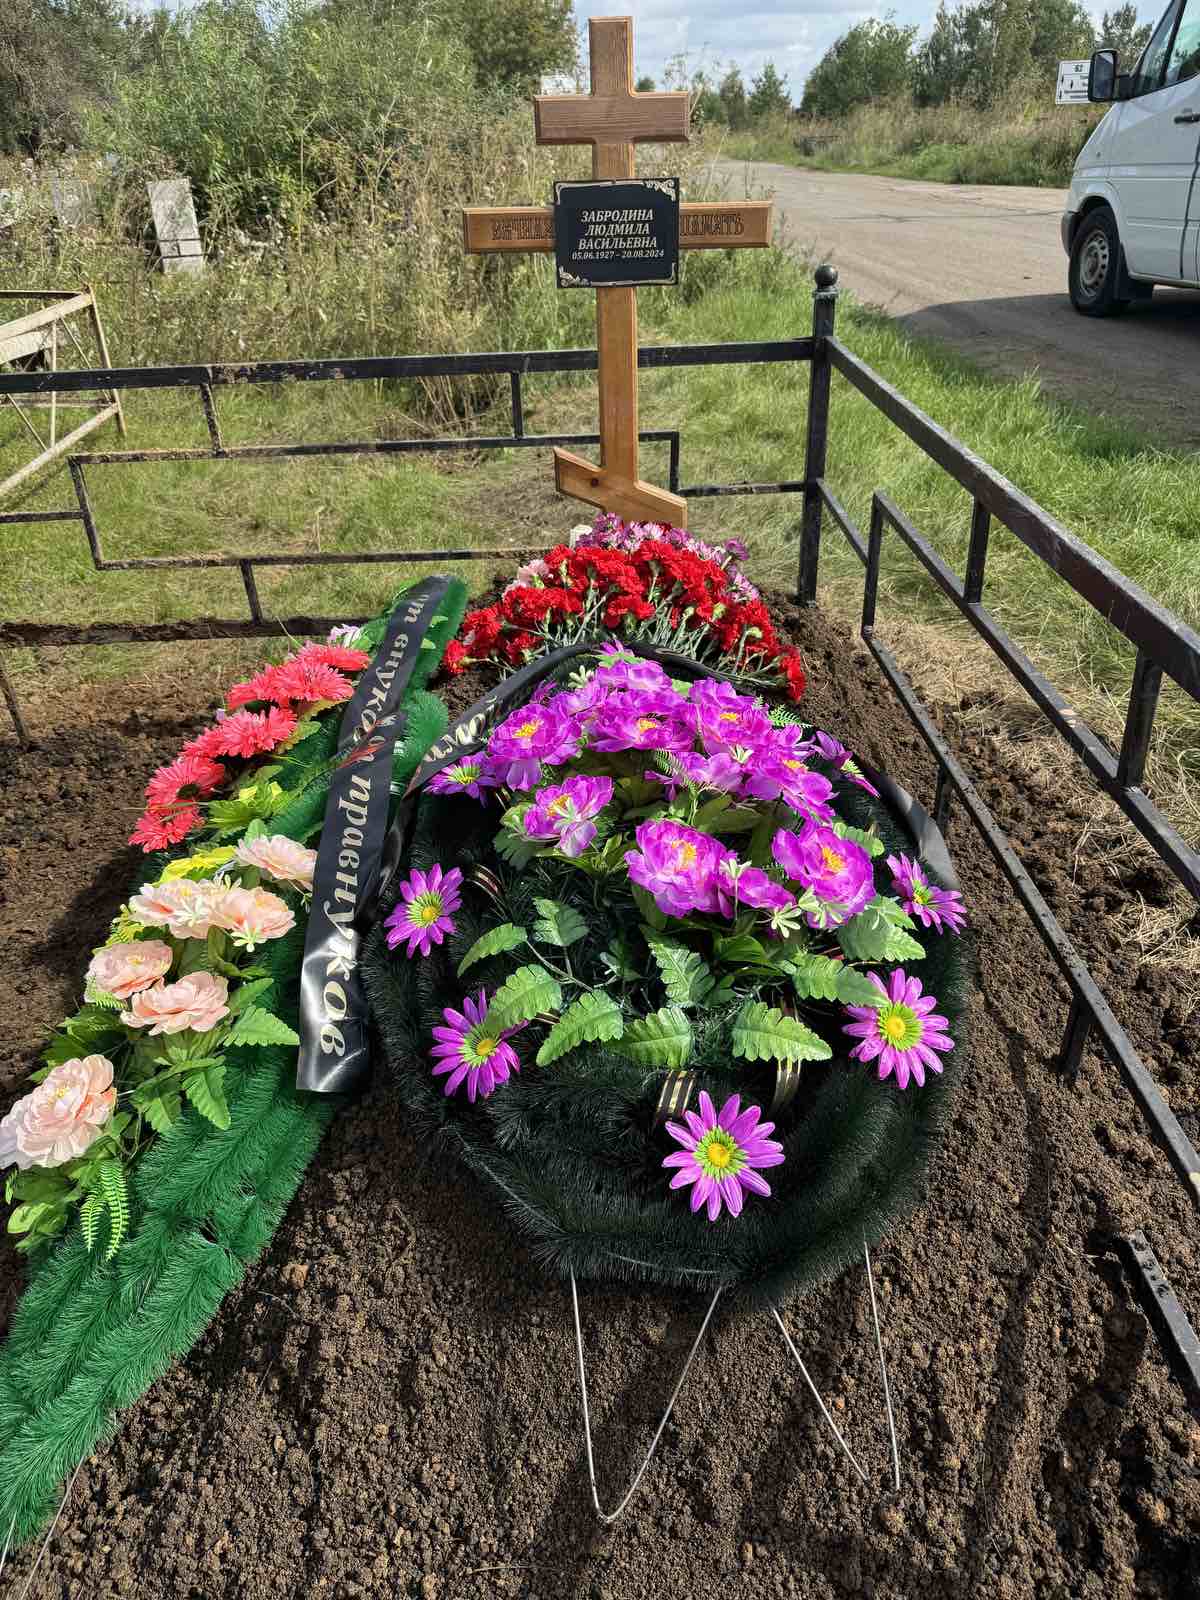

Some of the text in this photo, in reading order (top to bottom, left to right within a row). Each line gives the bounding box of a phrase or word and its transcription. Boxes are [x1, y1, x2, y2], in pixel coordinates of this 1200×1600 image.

[580, 209, 654, 223] ЗАБРОДИНА
[584, 223, 650, 237] ЛЮДМИЛА
[578, 237, 657, 250] ВАСИЛЬЕВНА
[571, 250, 615, 260] 05.06.1927
[621, 249, 665, 258] 20.08.2024
[320, 774, 372, 1057] правнуков
